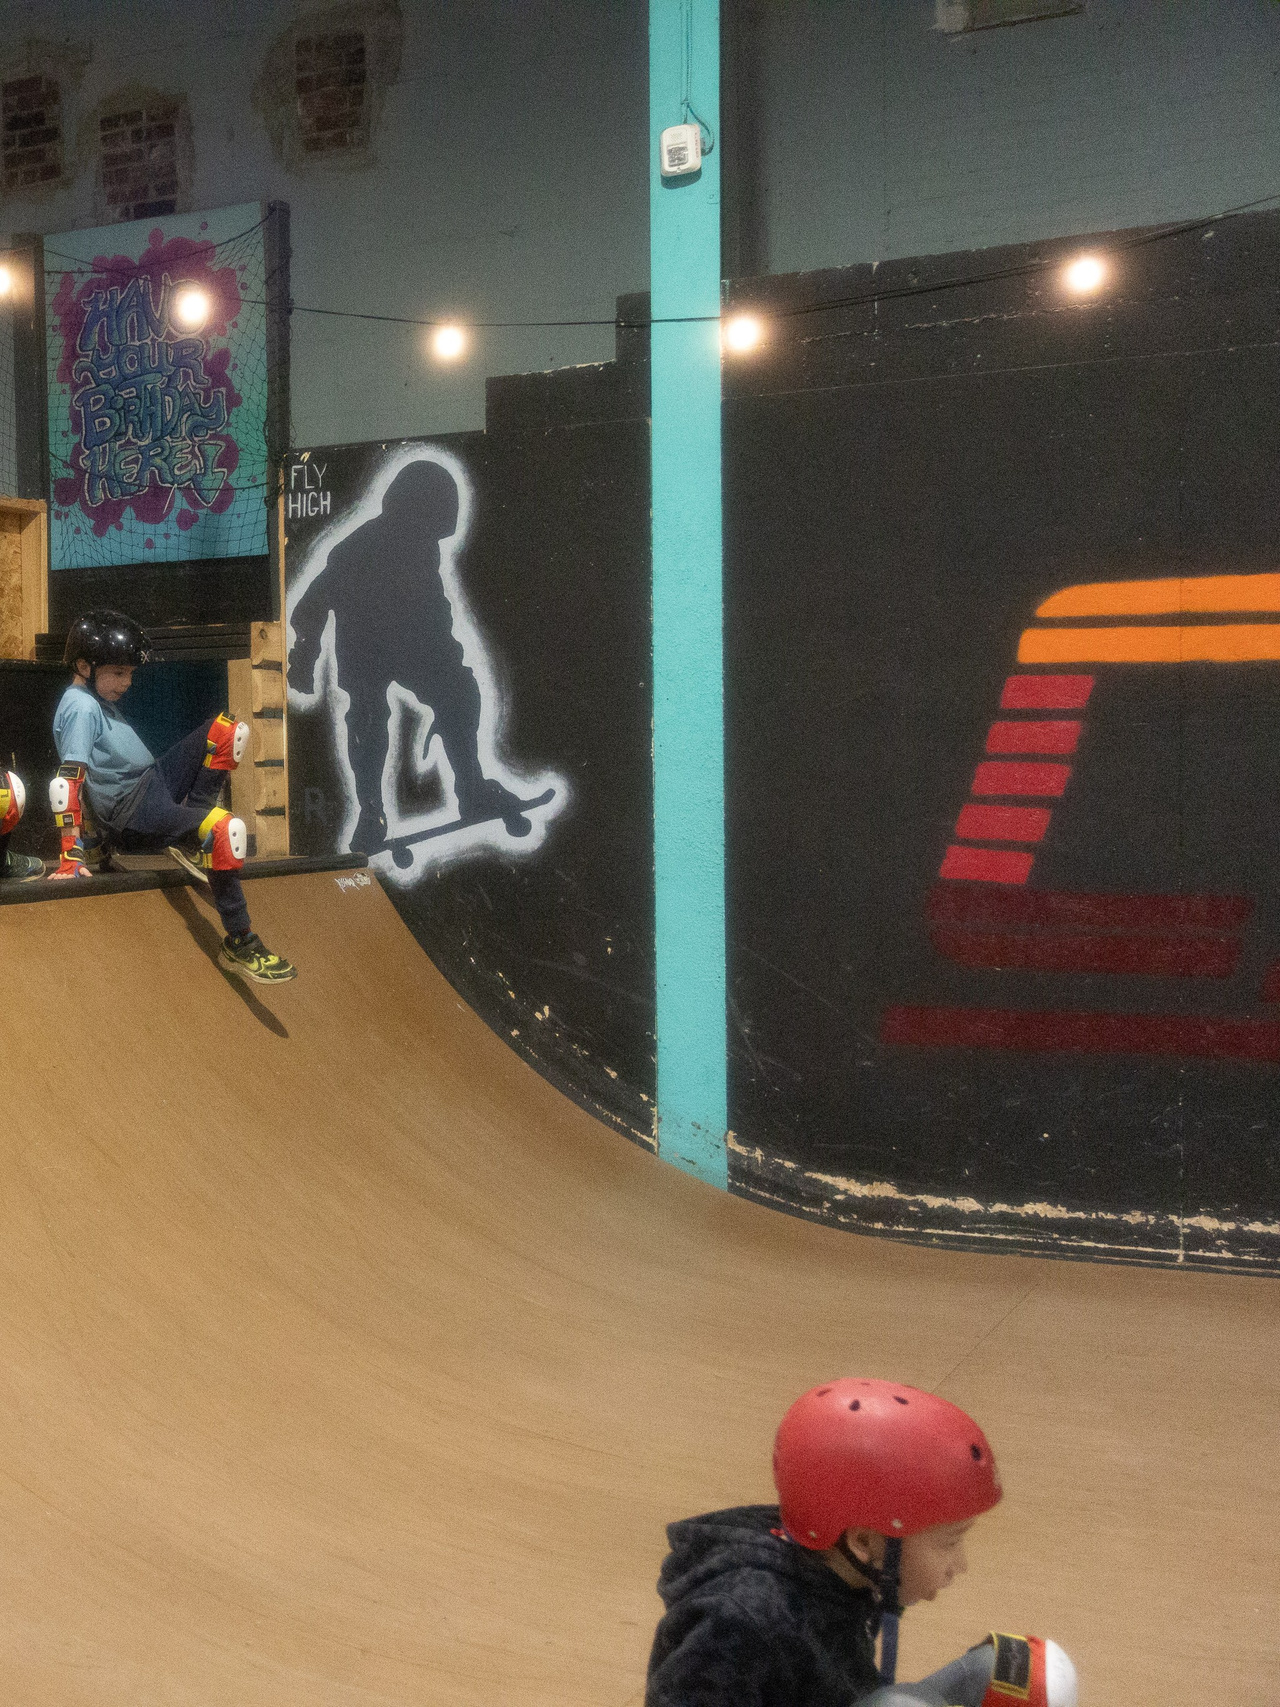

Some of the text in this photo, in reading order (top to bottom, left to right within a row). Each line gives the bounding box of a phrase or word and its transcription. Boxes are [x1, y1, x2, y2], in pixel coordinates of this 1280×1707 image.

[73, 337, 211, 389] YOUR
[290, 463, 328, 490] FLY
[288, 491, 332, 518] HIGH
